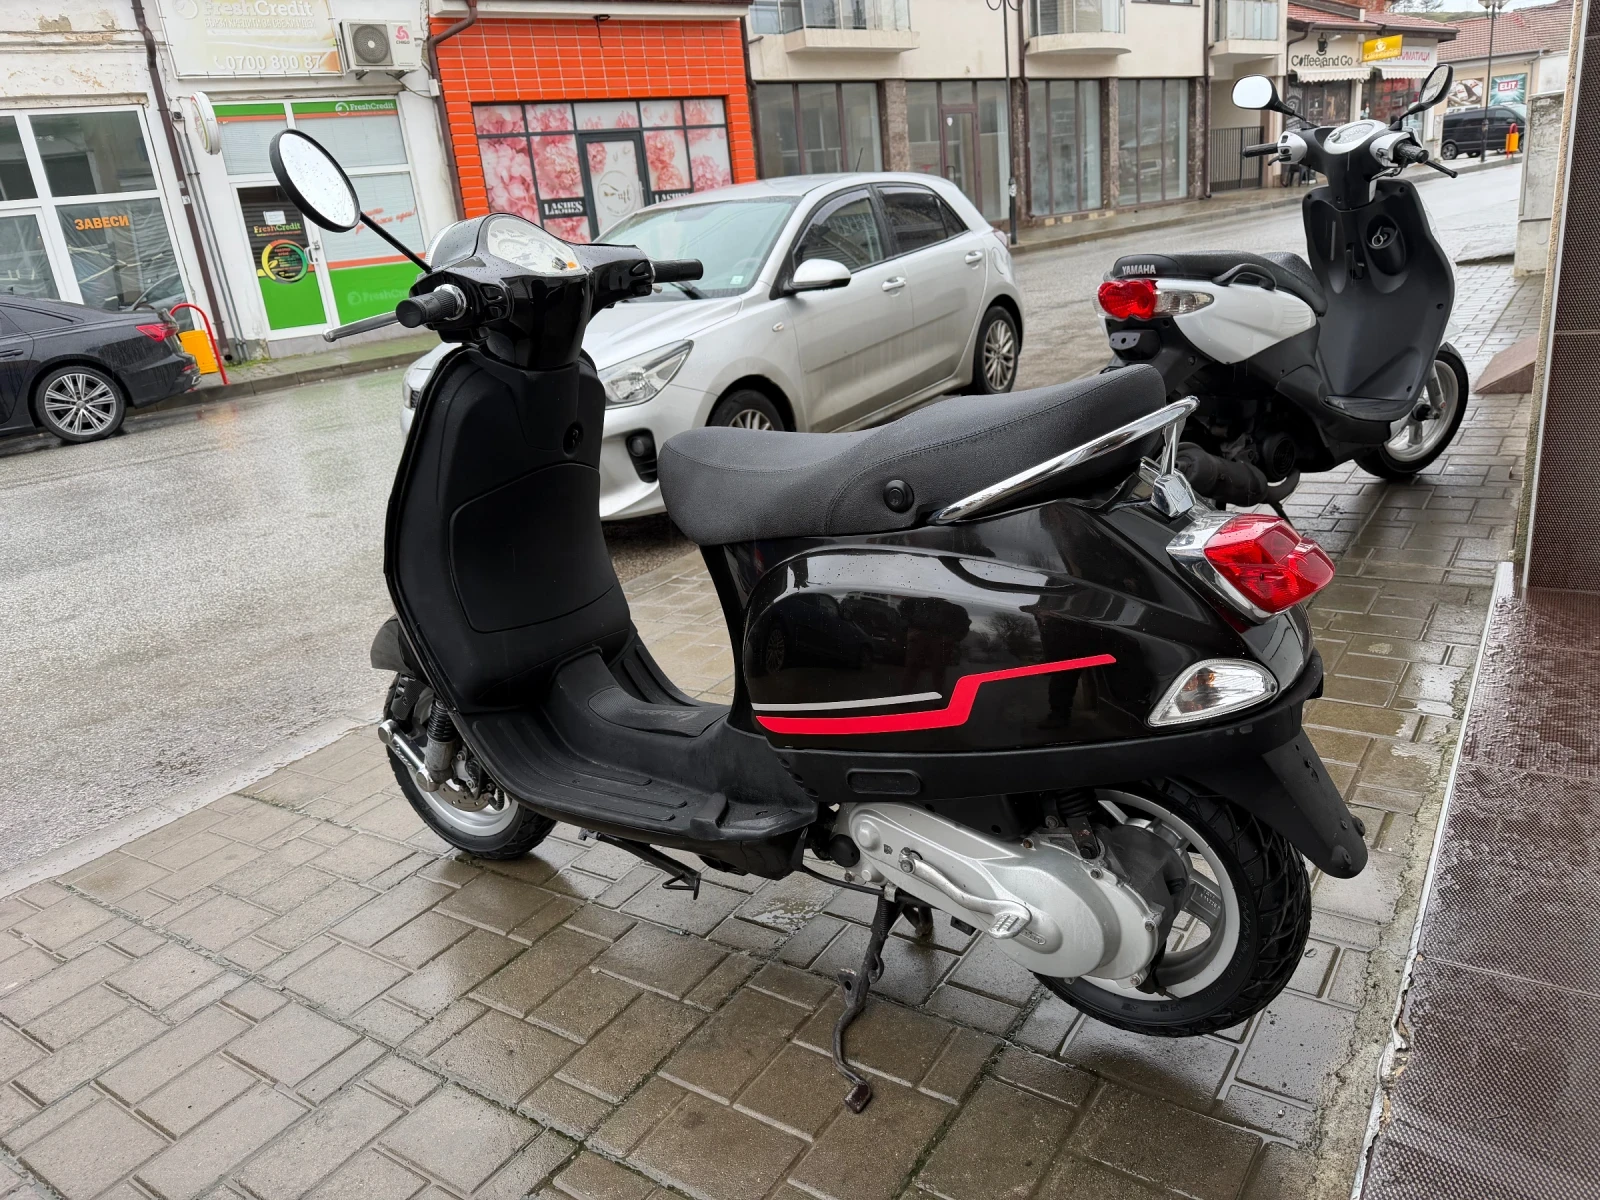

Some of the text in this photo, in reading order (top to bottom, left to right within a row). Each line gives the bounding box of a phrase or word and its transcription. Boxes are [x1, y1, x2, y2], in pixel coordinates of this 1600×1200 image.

[203, 0, 314, 16] FreshCredit
[225, 55, 267, 70] 0700
[271, 55, 299, 70] 800
[1291, 54, 1320, 67] Coffee
[1340, 55, 1353, 66] Go
[1500, 81, 1517, 90] ELIT
[350, 101, 394, 111] FreshCredit
[74, 215, 129, 230] ЗАВЕСИ
[253, 222, 301, 233] FreshCredit
[1122, 264, 1156, 275] YAMAHA
